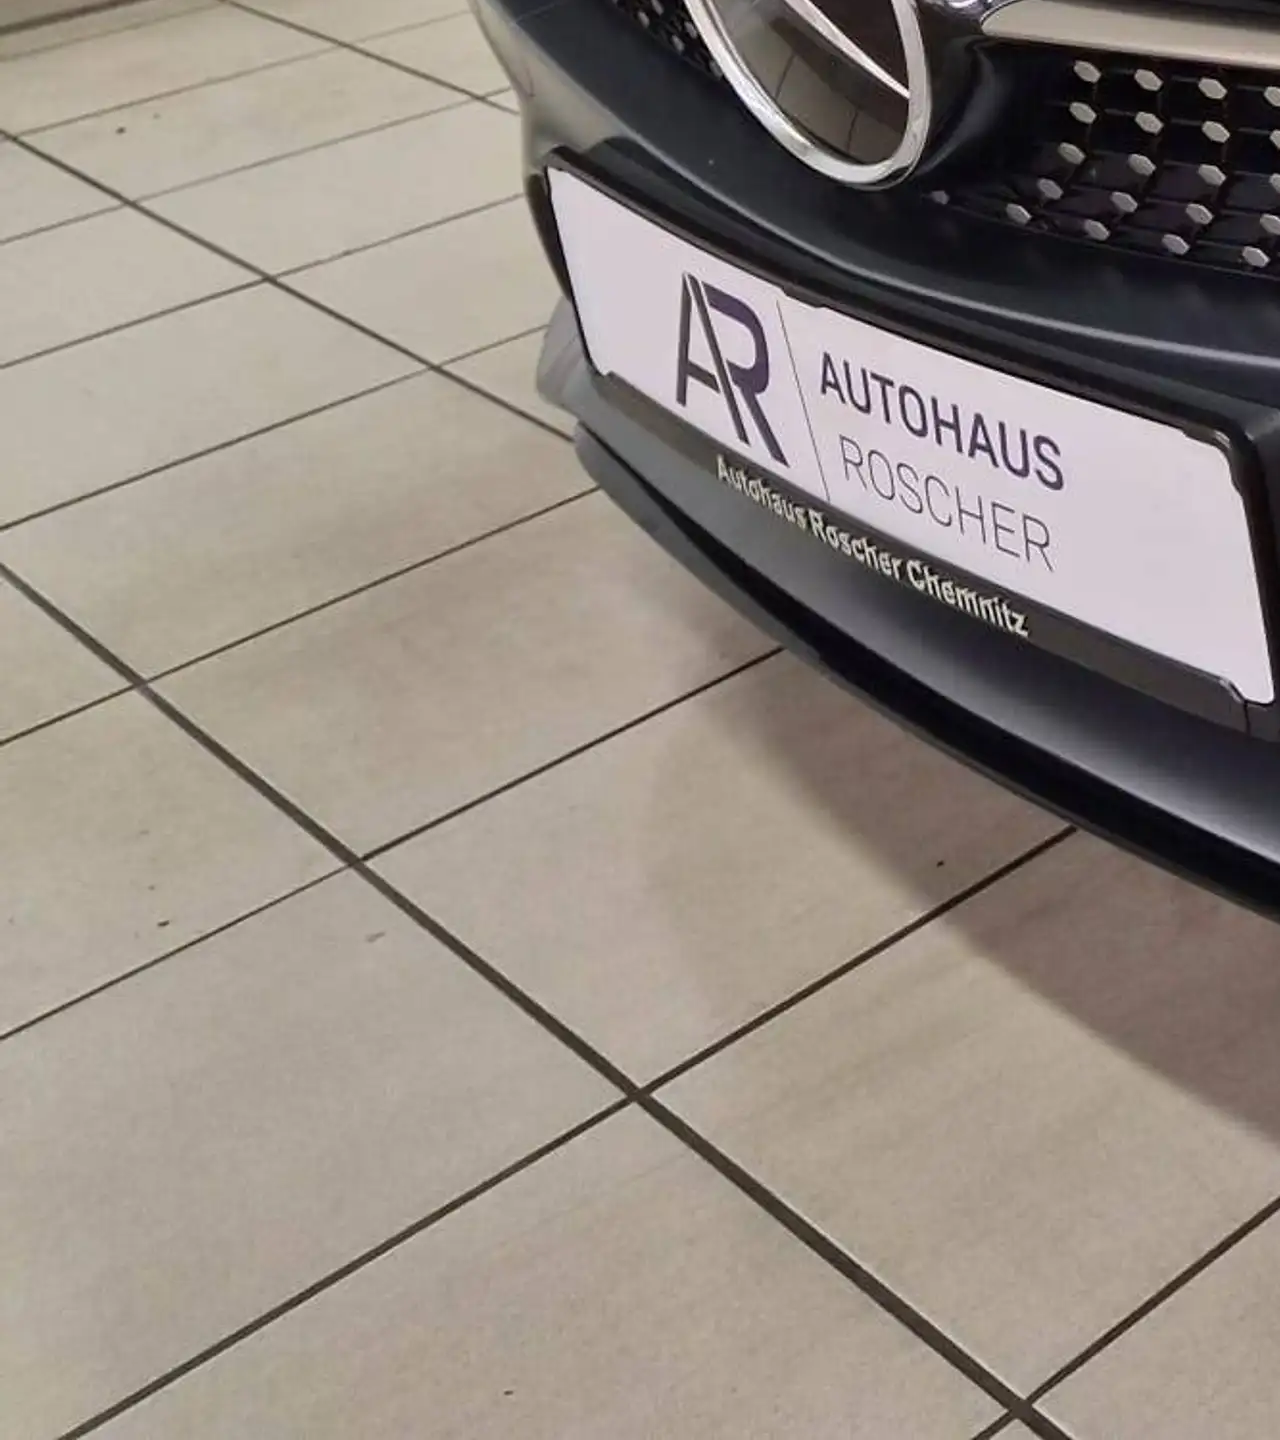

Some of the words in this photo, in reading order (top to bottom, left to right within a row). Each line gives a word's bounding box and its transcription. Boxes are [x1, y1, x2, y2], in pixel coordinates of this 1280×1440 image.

[820, 351, 1065, 491] AUTOHAUS
[716, 454, 807, 530] Autohaus
[809, 510, 902, 582] Roscher
[906, 558, 1029, 638] Chemnitz
[839, 434, 1054, 573] ROSCHER
